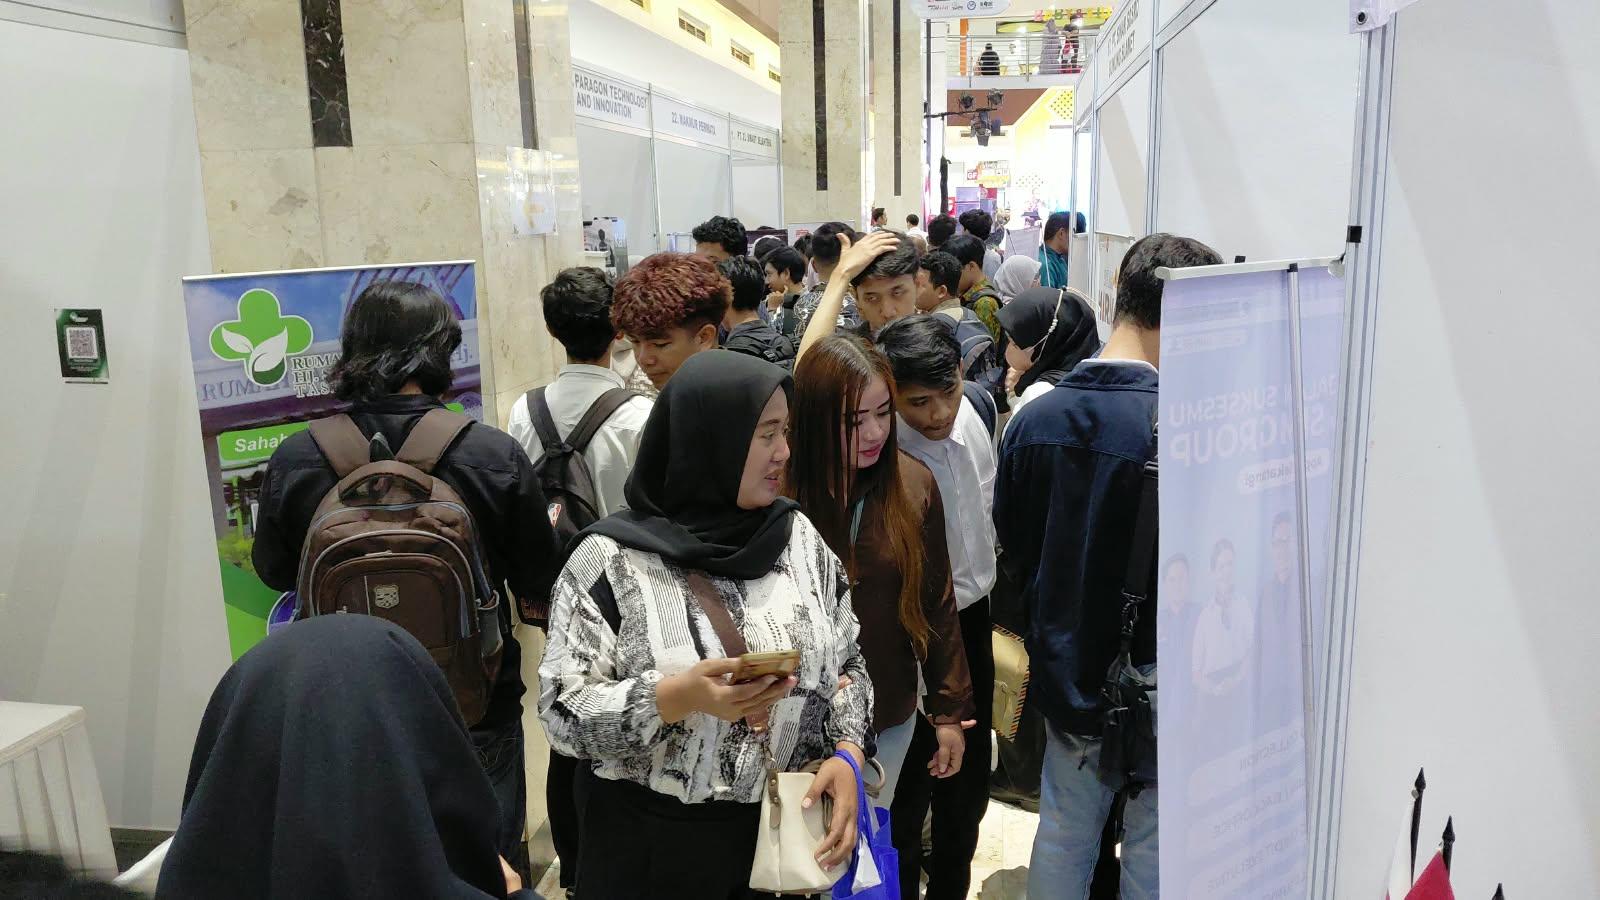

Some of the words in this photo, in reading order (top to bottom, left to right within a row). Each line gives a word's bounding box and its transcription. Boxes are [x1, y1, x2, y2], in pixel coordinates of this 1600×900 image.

[575, 74, 608, 97] PARAGON
[610, 85, 647, 109] TECHNOLOGY
[577, 92, 592, 108] AND
[593, 95, 632, 119] INNOVATION
[291, 352, 342, 369] RUMA
[294, 382, 336, 398] TAS
